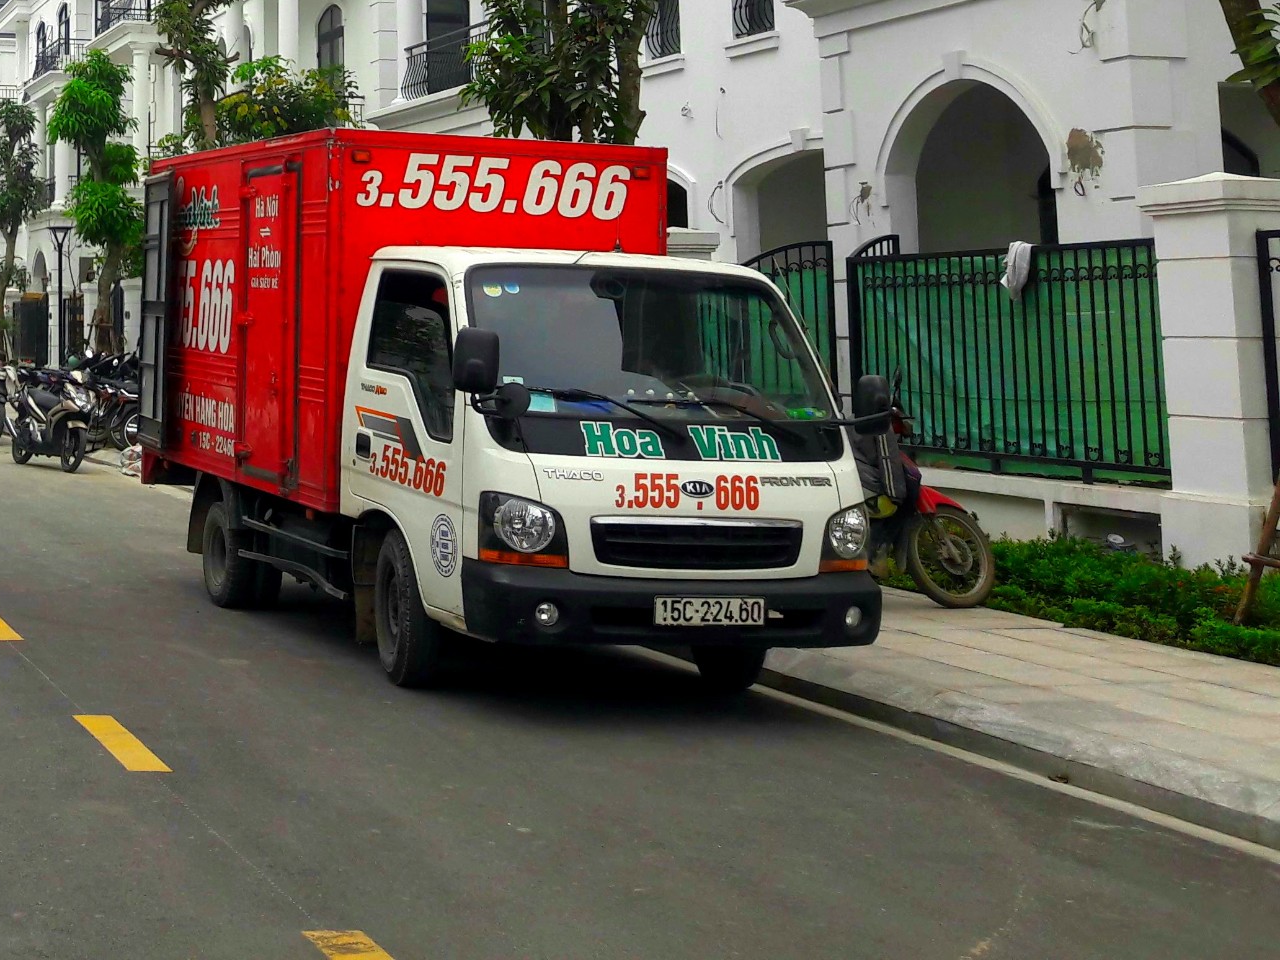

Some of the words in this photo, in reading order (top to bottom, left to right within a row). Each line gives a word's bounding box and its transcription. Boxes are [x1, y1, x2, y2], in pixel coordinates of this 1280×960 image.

[356, 152, 631, 221] 3.555.666
[255, 195, 265, 218] Hà
[266, 194, 279, 222] Nội
[248, 243, 260, 268] Hải
[195, 391, 217, 428] HÀNG
[217, 397, 235, 433] HÓA
[199, 431, 211, 450] 15C
[579, 421, 666, 459] Hoa
[686, 425, 782, 462] Vinh
[369, 444, 447, 497] 3.555.666
[543, 469, 604, 482] THACO
[760, 476, 832, 487] FRONTIER
[661, 599, 761, 623] 15C-224.60
